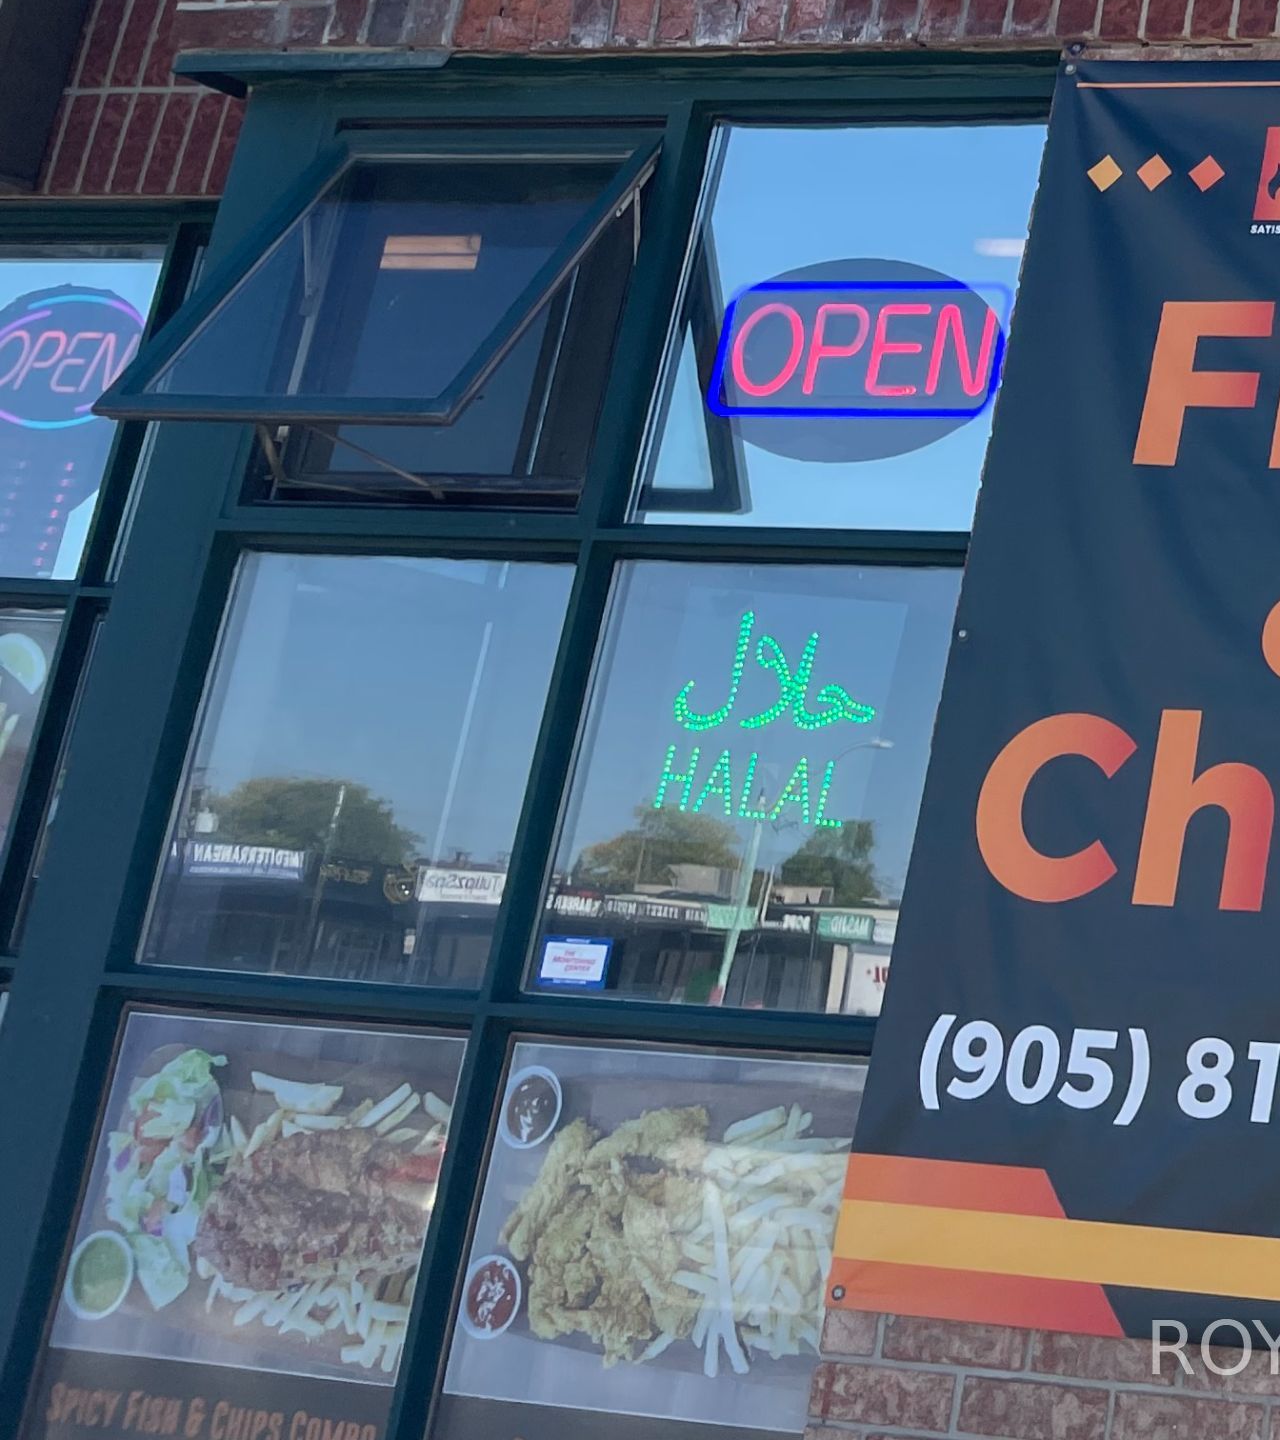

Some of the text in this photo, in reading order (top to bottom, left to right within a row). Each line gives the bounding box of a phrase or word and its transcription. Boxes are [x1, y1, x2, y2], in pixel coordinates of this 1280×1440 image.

[0, 330, 140, 392] OPEN
[730, 303, 998, 398] OPEN
[674, 611, 875, 730] حلال
[654, 744, 842, 828] HALAL
[918, 1014, 1151, 1127] (905)
[47, 1382, 122, 1427] SPICY
[122, 1390, 183, 1436] FISH
[210, 1401, 284, 1440] CHIPS
